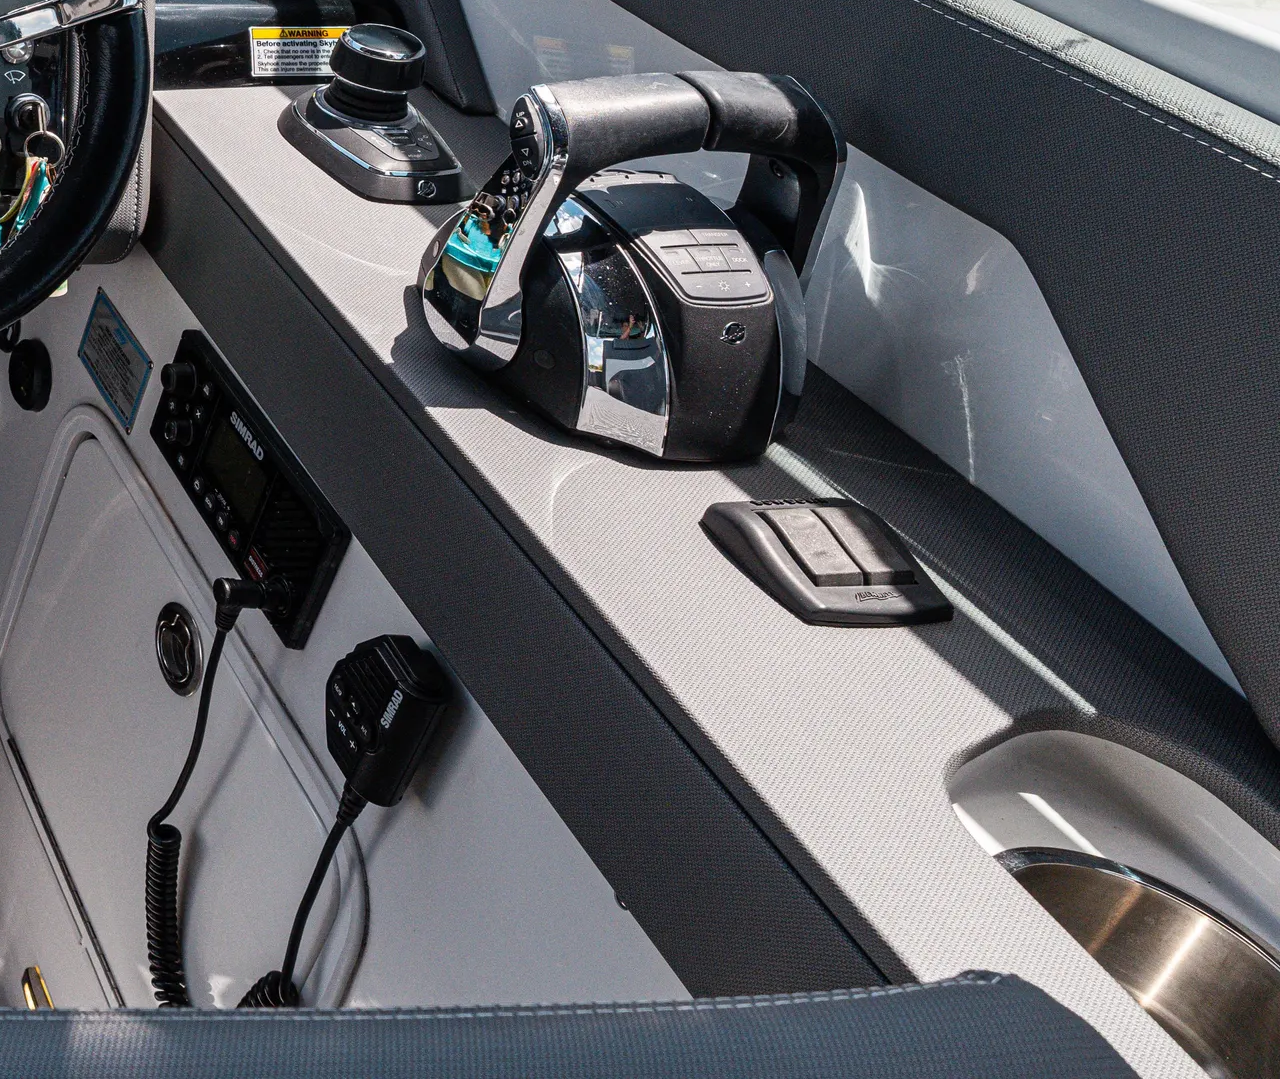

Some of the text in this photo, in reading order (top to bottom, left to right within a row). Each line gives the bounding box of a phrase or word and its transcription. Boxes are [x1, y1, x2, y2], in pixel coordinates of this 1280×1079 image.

[230, 411, 264, 461] SIMRAD
[338, 720, 346, 736] VOL
[380, 690, 403, 728] SIMRAD
